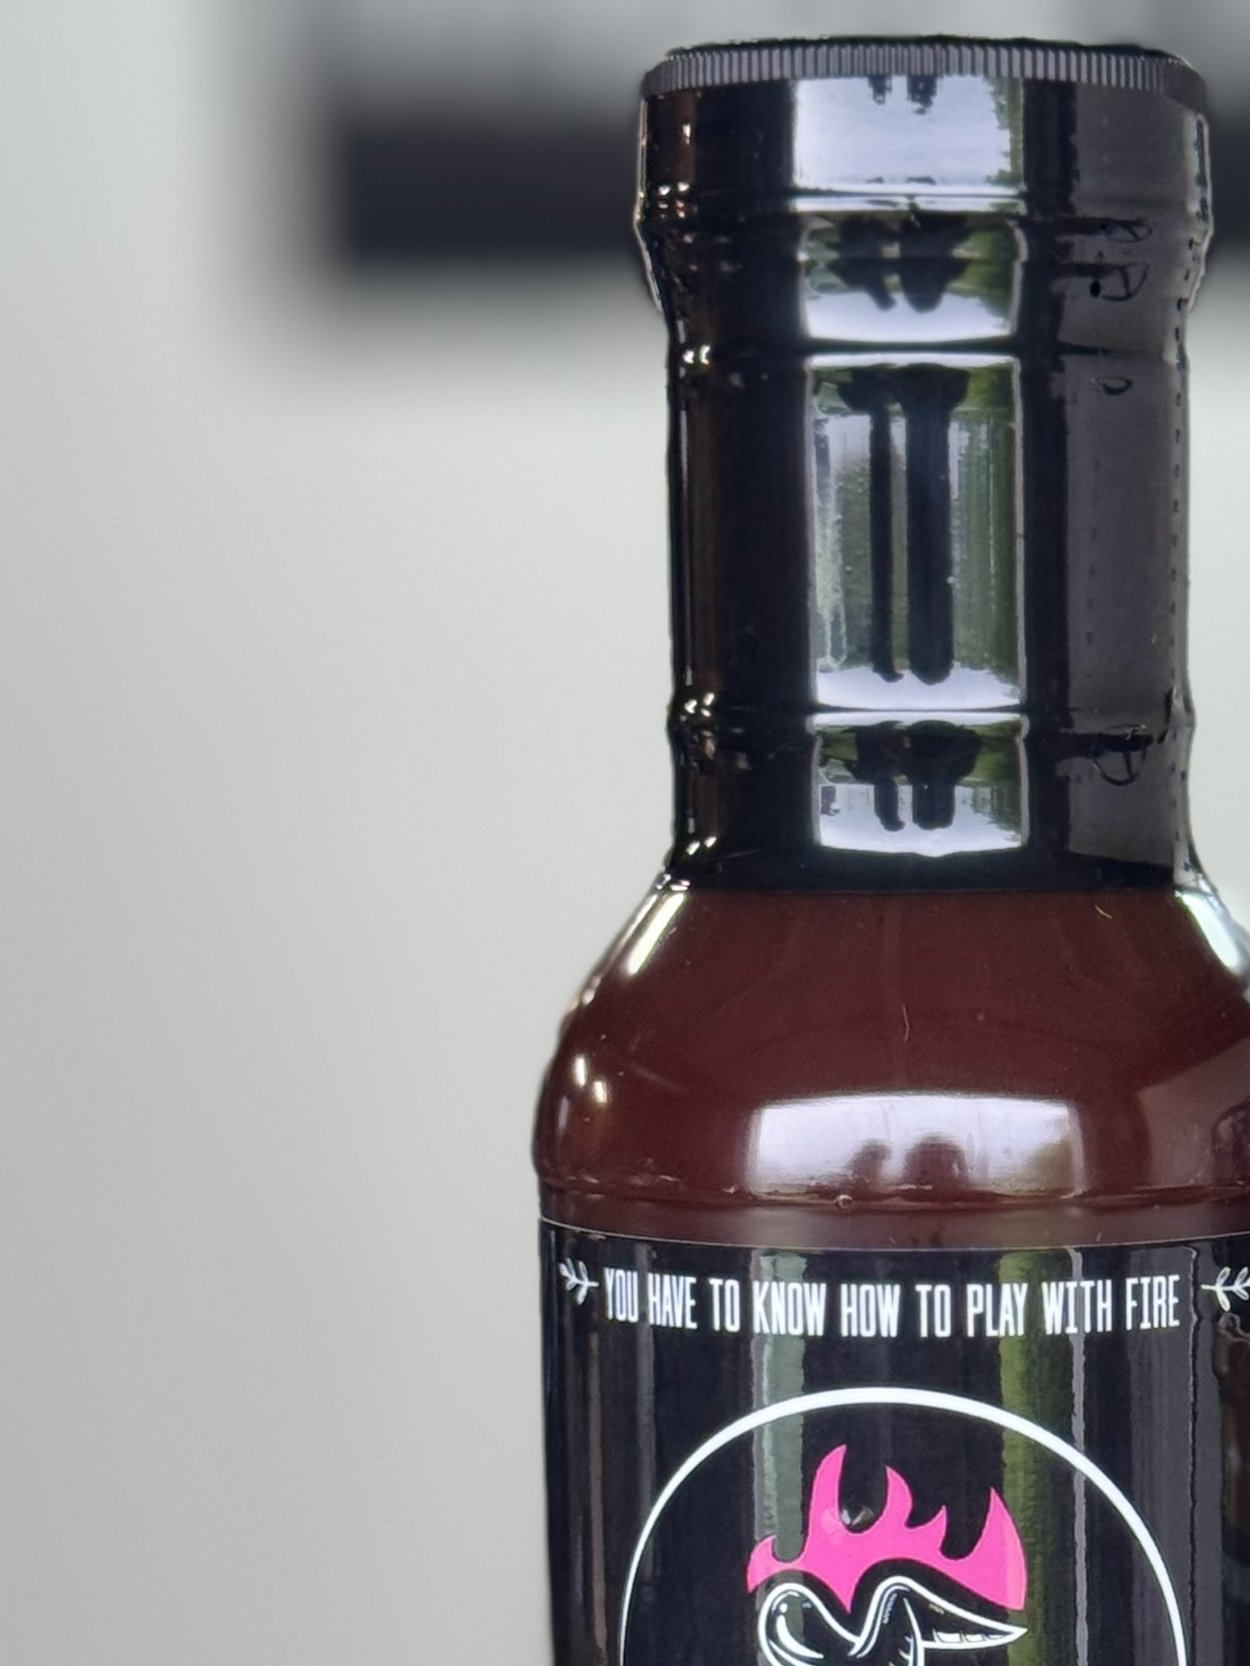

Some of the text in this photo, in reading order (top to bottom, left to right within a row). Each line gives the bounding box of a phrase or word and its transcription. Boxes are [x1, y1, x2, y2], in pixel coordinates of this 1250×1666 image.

[604, 1267, 1180, 1338] YOU HAVE TO KNOW HOW TO PLAY WITH FIRE
